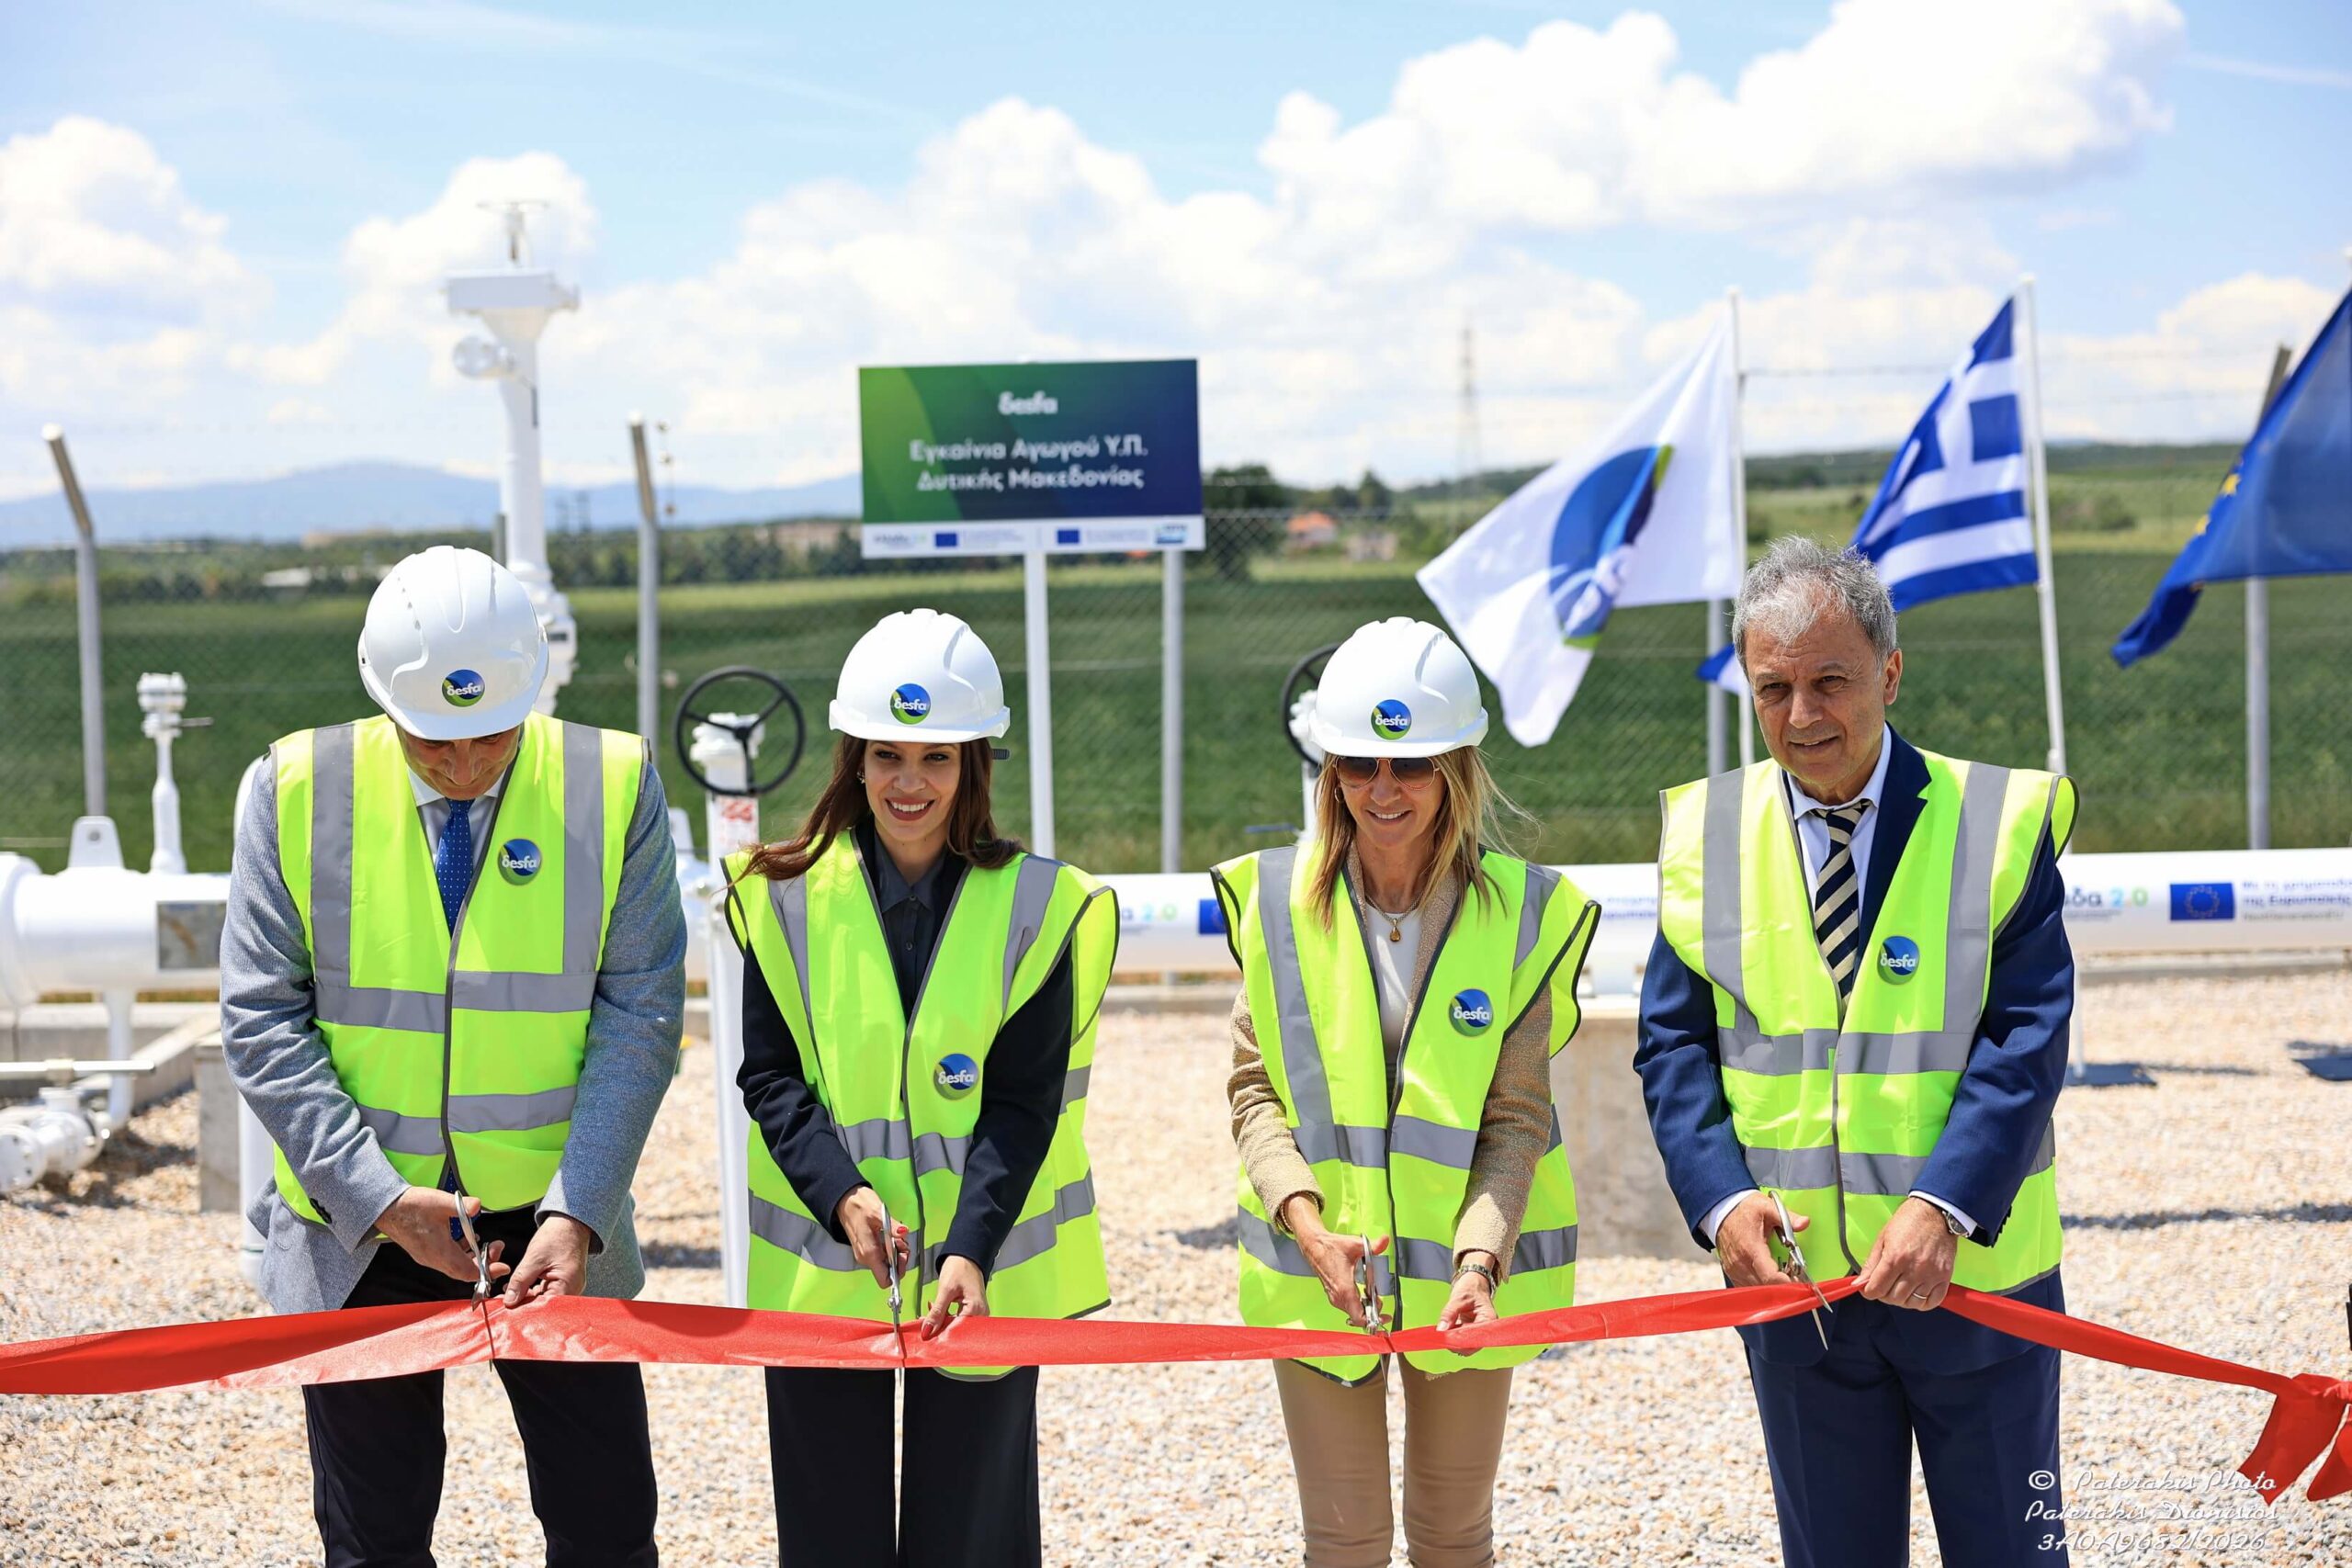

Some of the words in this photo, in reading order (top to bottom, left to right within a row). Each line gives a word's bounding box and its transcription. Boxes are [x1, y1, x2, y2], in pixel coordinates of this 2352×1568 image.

[1011, 435, 1100, 464] Αγωγού
[917, 468, 1004, 491] Δυτικής
[1008, 463, 1145, 490] Μακεδονίας
